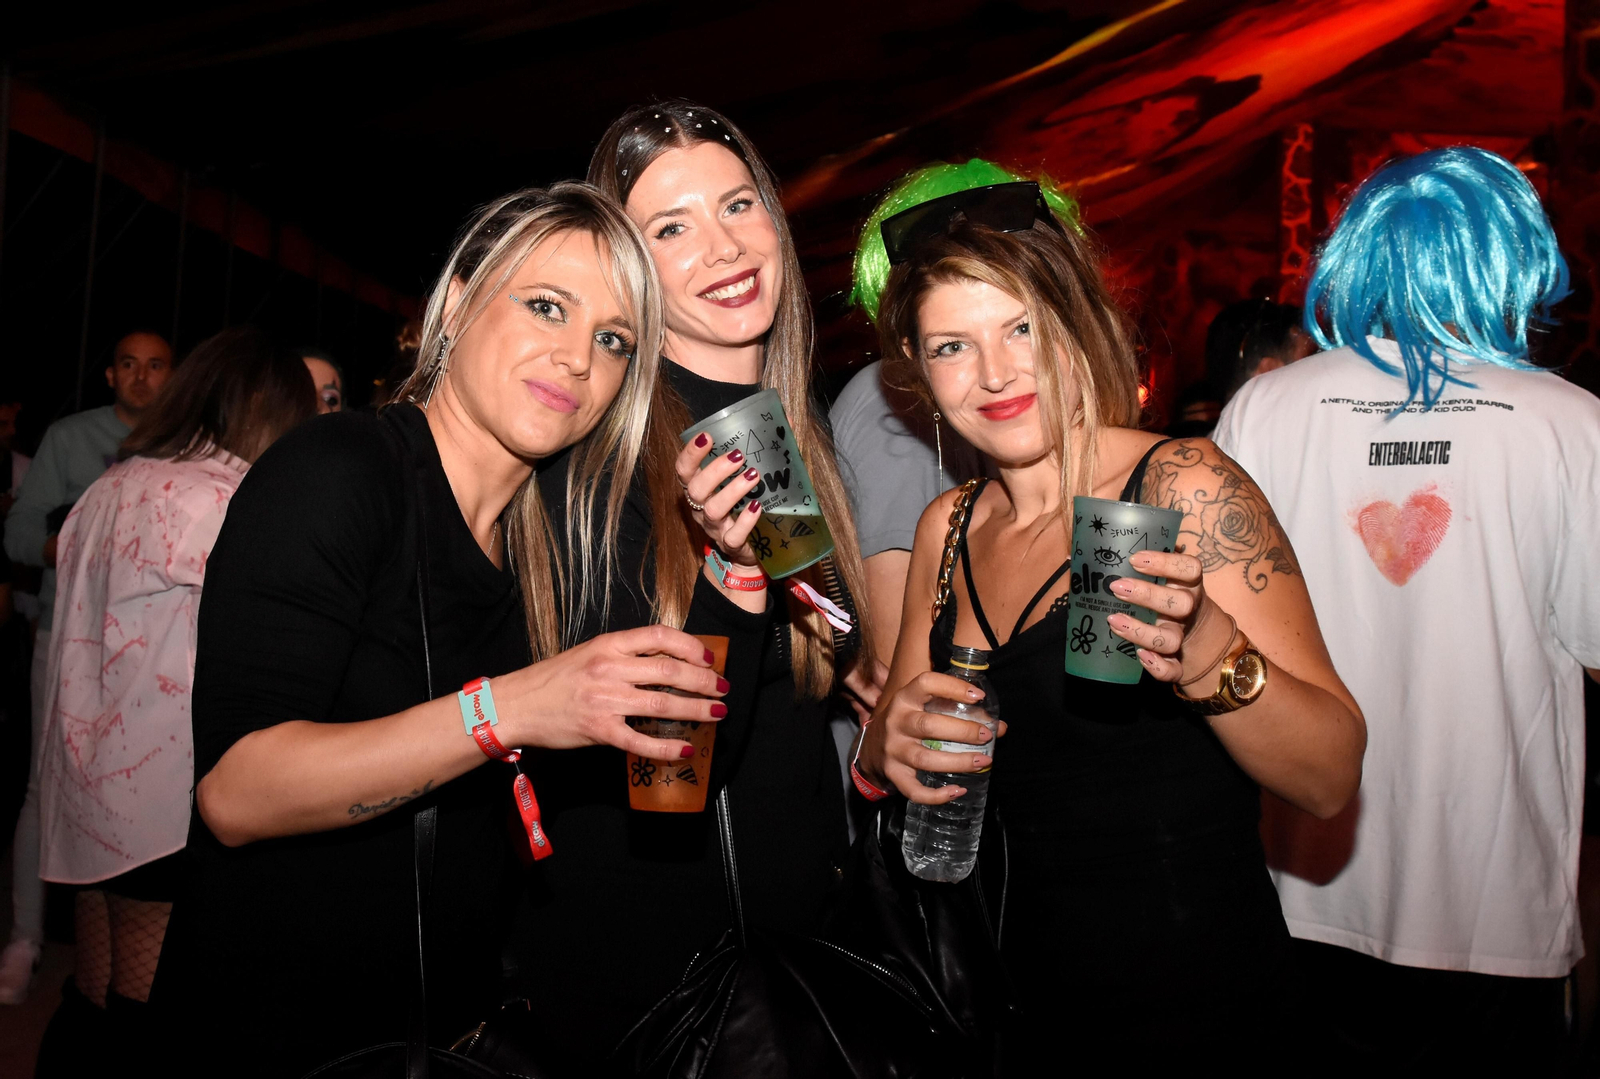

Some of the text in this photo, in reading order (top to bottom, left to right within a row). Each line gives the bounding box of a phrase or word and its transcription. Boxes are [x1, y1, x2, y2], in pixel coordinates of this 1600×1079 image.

[1328, 397, 1366, 406] NETFLIX
[1442, 398, 1474, 406] KENYA
[1475, 399, 1515, 412] BARRIS
[1351, 406, 1373, 414] AND
[1452, 405, 1476, 413] CUDI
[724, 435, 739, 449] FUN
[1368, 440, 1452, 466] ENTERGALACTIC
[1115, 527, 1135, 537] FUN
[742, 578, 765, 589] MAGIC
[473, 693, 485, 721] elrow
[516, 773, 546, 847] elrow TOGETHER
